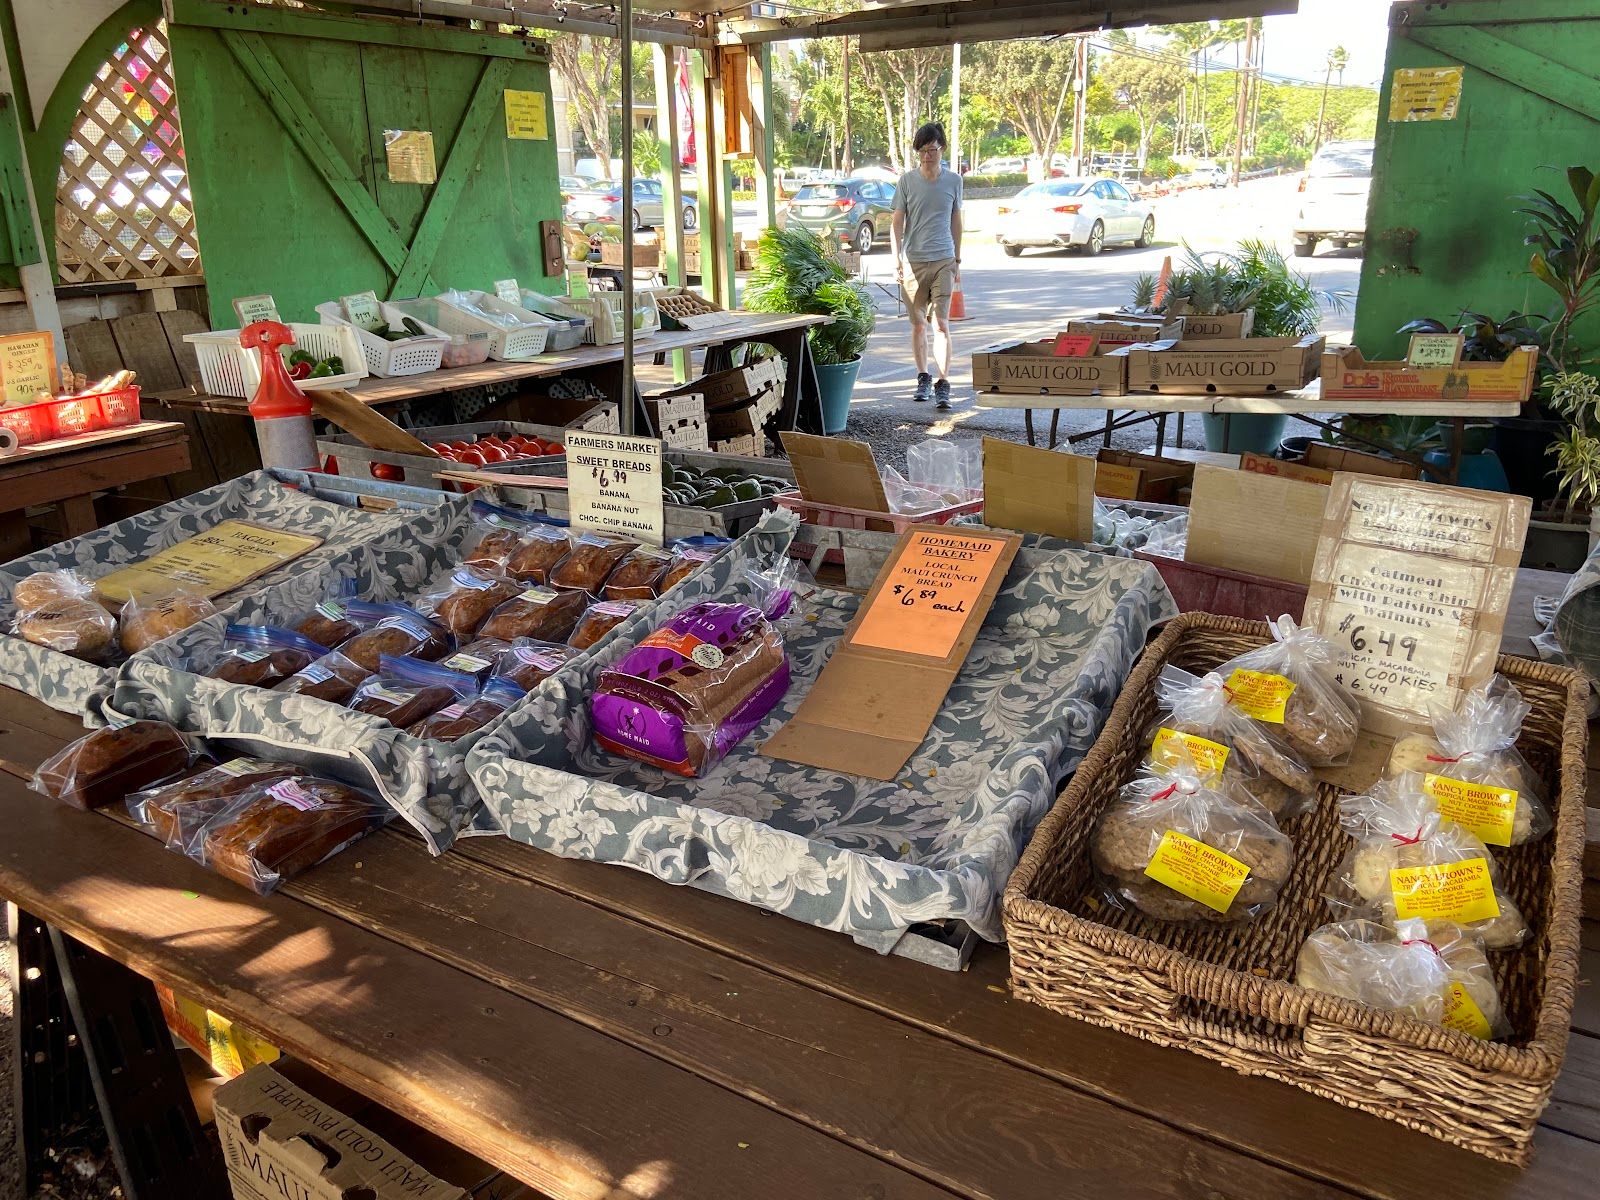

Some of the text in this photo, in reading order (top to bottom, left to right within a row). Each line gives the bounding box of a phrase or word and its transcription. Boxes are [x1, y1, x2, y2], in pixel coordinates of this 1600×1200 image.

[1005, 365, 1100, 380] MAUI GOLD
[1164, 361, 1276, 376] MAUI GOLD
[1343, 372, 1379, 386] Dole
[568, 436, 658, 454] FARMERS MARKET
[576, 456, 652, 472] SWEET BREADS
[1246, 458, 1279, 476] Dole
[600, 490, 630, 500] BANANA
[592, 502, 640, 514] BANANA NUT
[580, 514, 654, 531] CHOC. CHIP BANANA
[231, 530, 279, 548] BAGELS
[920, 536, 992, 551] HOMEMAID
[924, 547, 978, 560] BAKERY
[925, 561, 961, 572] LOCAL
[901, 567, 978, 583] MAUI CRUNCH
[916, 578, 952, 588] BREAD
[1370, 566, 1443, 588] Oatmeal
[1340, 573, 1470, 608] Chocolate Chip
[932, 600, 964, 613] each
[1340, 588, 1460, 620] with Raisins &
[1362, 605, 1432, 628] Walnuts
[1338, 613, 1418, 662] $6.49
[1336, 662, 1357, 670] NUT
[634, 735, 650, 746] MAID
[1186, 741, 1225, 756] BROWN'S
[1432, 782, 1464, 795] NANCY
[1432, 790, 1507, 808] TROPICAL MACADAMIA
[1464, 803, 1489, 811] COOKIE
[1170, 834, 1201, 852] NANCY
[1202, 850, 1244, 876] BROWN'S
[1172, 844, 1198, 860] OATMEAL
[1200, 856, 1236, 878] CHOCOLATE
[1182, 856, 1220, 878] CHIP COOKIE
[1396, 866, 1484, 885] NANCY BROWN'S
[1420, 884, 1466, 896] NUT COOKIE
[259, 1080, 437, 1196] MAUI GOLD PINEAPPLE
